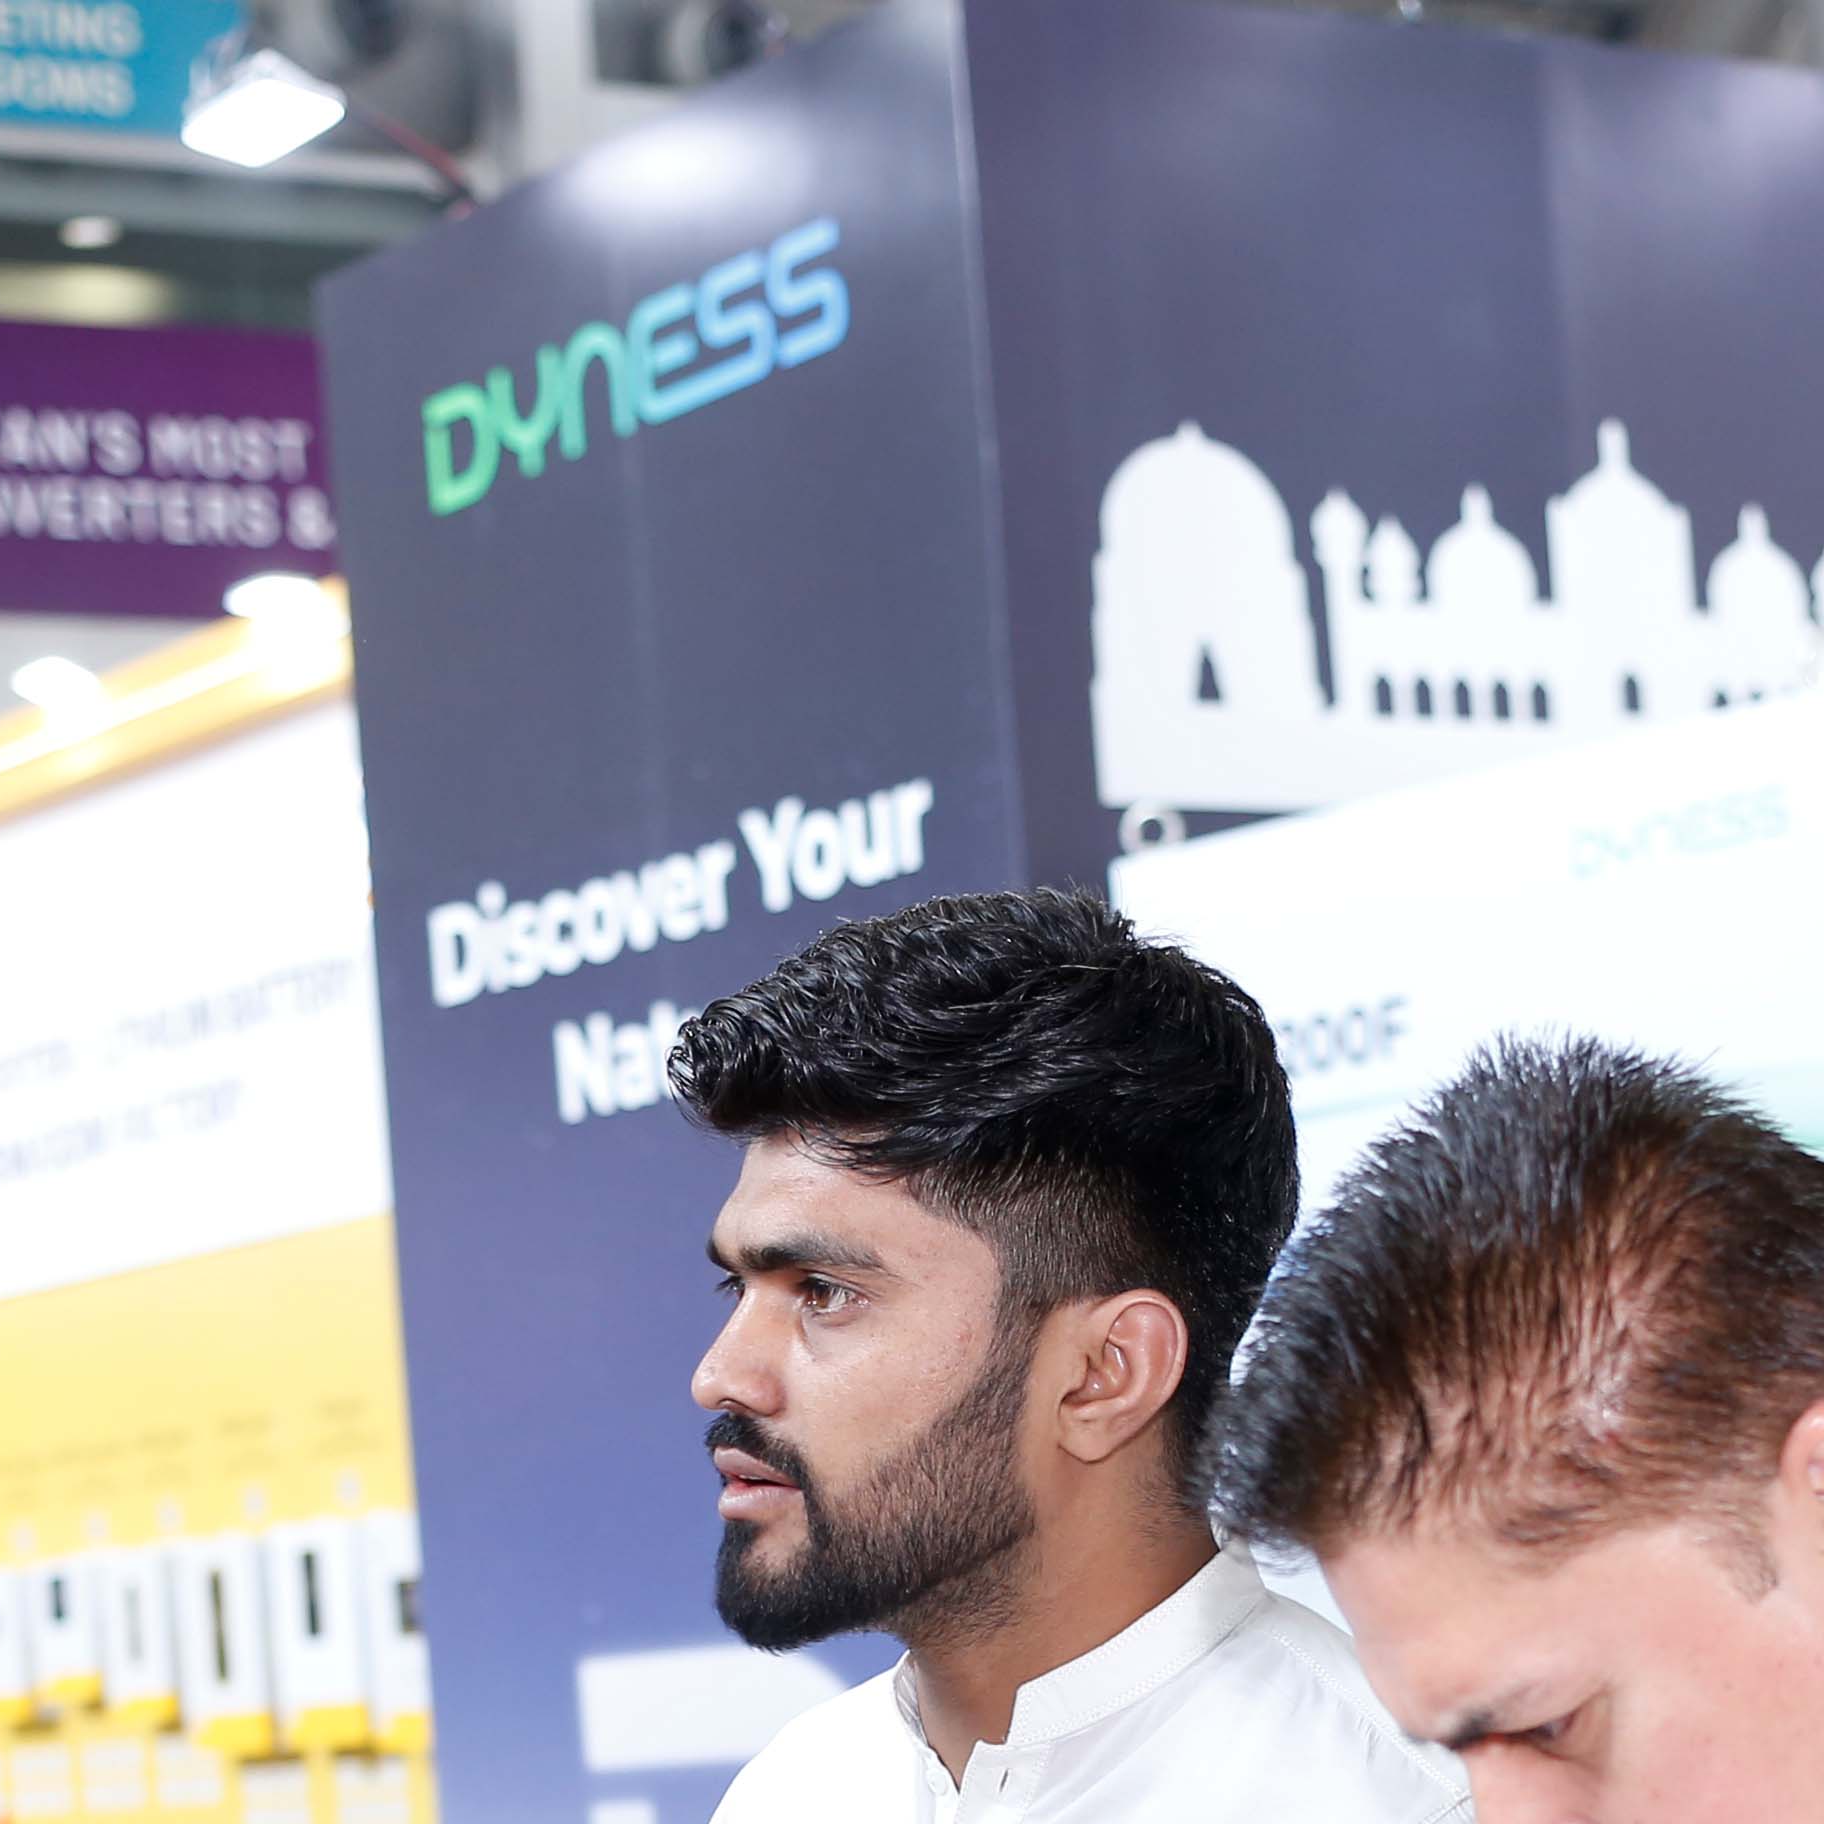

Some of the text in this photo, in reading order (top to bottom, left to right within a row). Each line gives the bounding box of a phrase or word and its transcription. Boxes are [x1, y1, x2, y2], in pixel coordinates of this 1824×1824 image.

[148, 412, 313, 484] MOST
[422, 215, 852, 518] DYNESS
[427, 776, 935, 1009] Discover Your
[552, 998, 702, 1126] Nat
